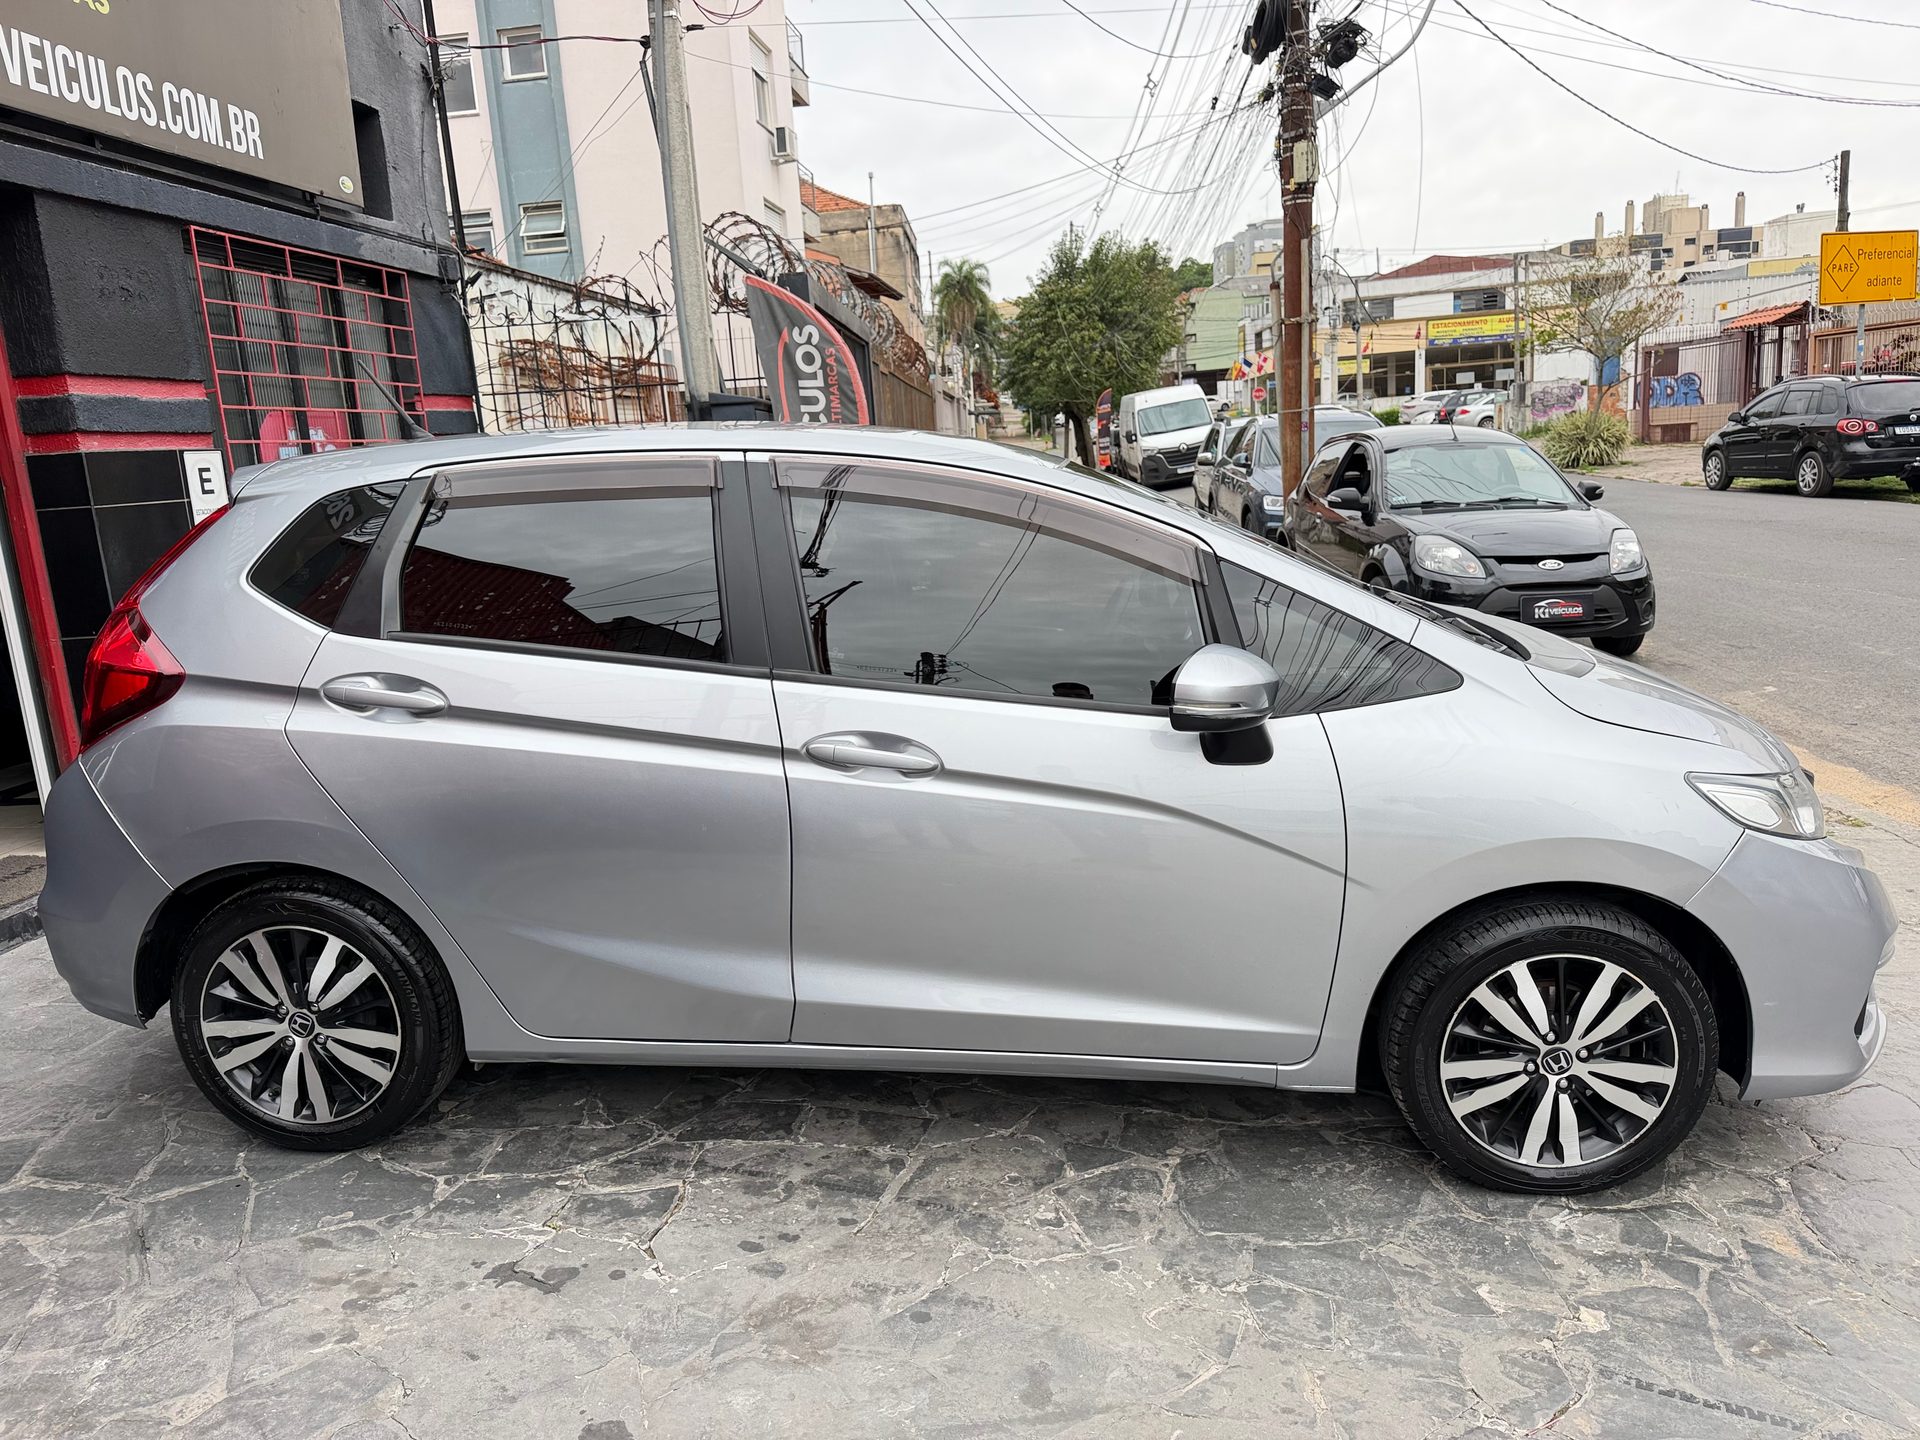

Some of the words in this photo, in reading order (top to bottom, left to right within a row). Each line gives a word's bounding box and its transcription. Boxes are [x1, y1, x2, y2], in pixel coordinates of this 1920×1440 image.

[1857, 247, 1915, 260] Preferencial
[1831, 262, 1854, 273] PARE
[1866, 275, 1902, 287] adiante
[824, 347, 842, 423] TIMARCAS
[198, 467, 215, 495] E
